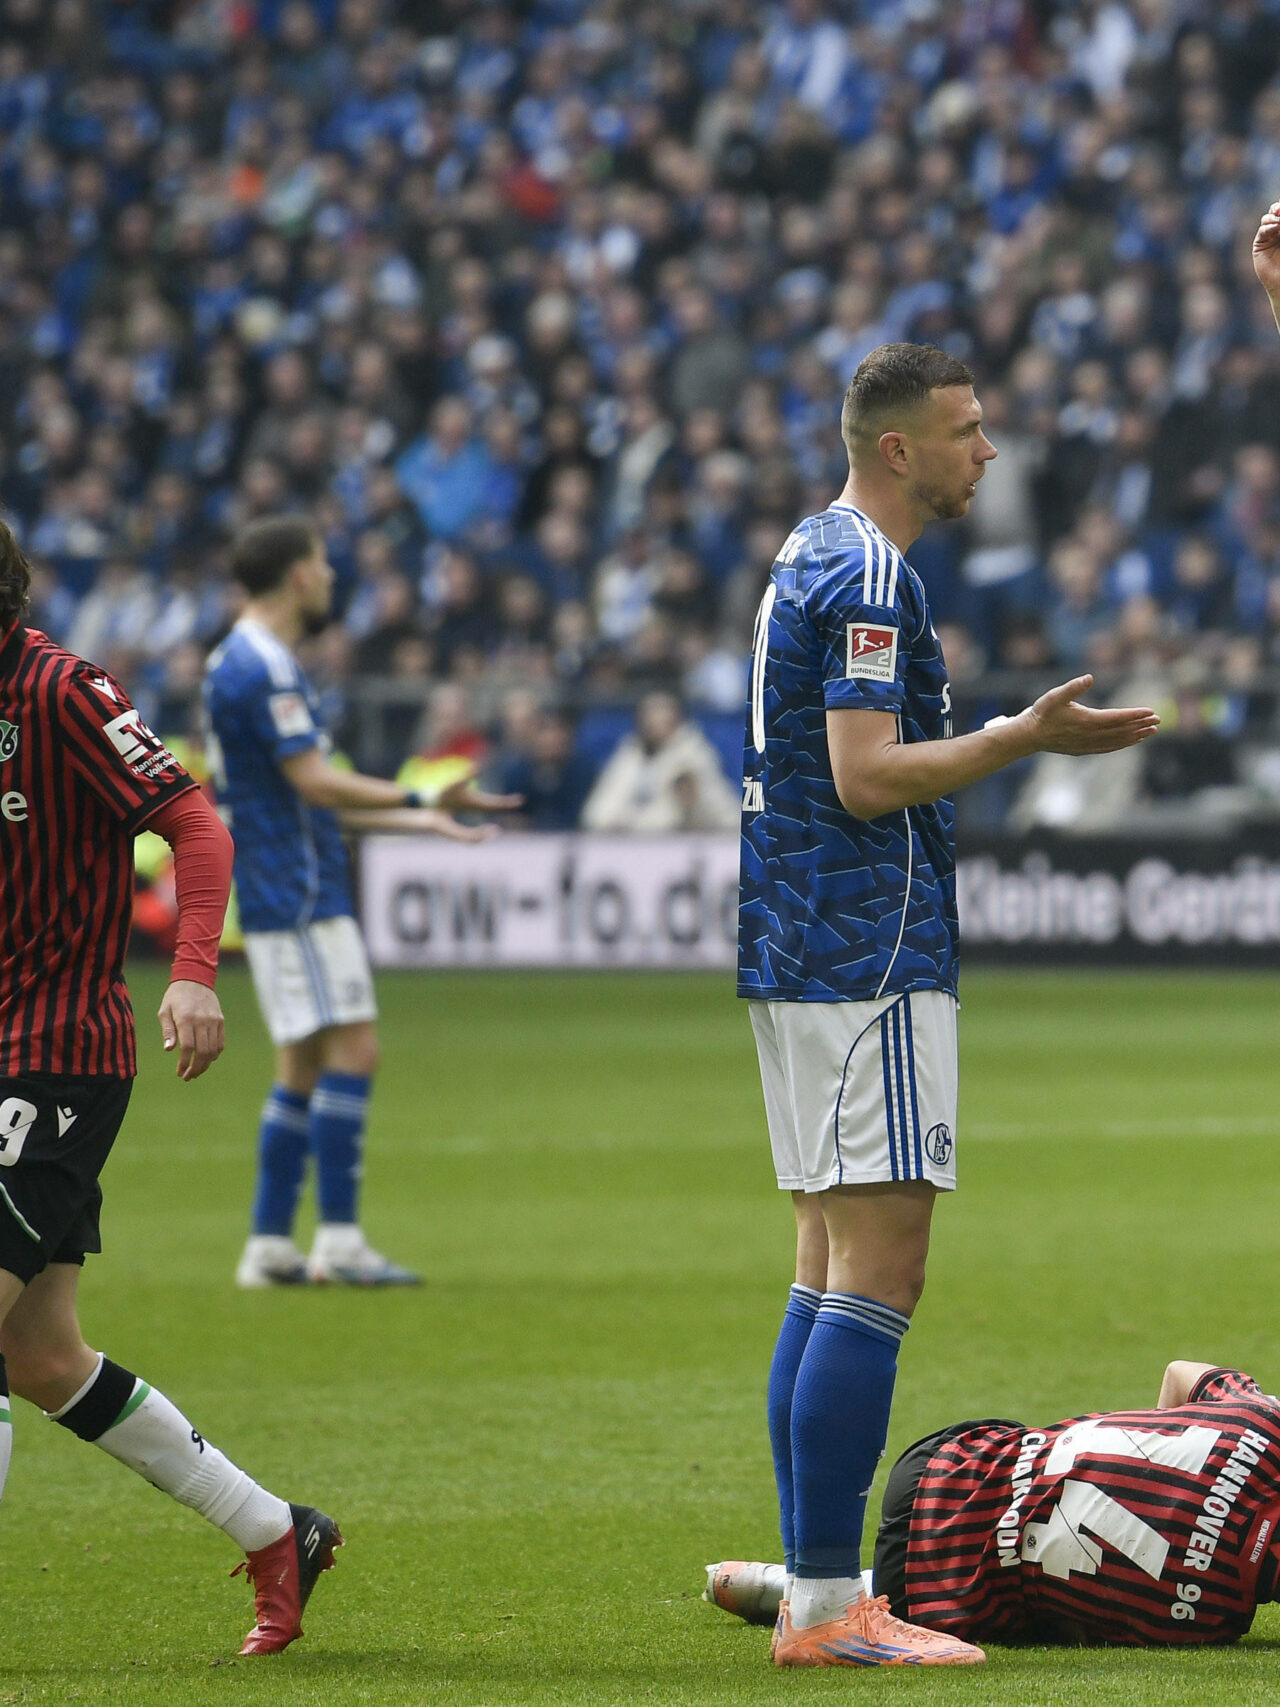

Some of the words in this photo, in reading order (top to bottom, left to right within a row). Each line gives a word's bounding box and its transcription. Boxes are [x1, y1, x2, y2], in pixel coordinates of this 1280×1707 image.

[850, 667, 890, 678] BUNDESLIGA
[877, 649, 890, 666] 2
[1021, 1419, 1223, 1581] 14
[1183, 1428, 1270, 1572] HANNOVER
[1170, 1582, 1202, 1621] 96
